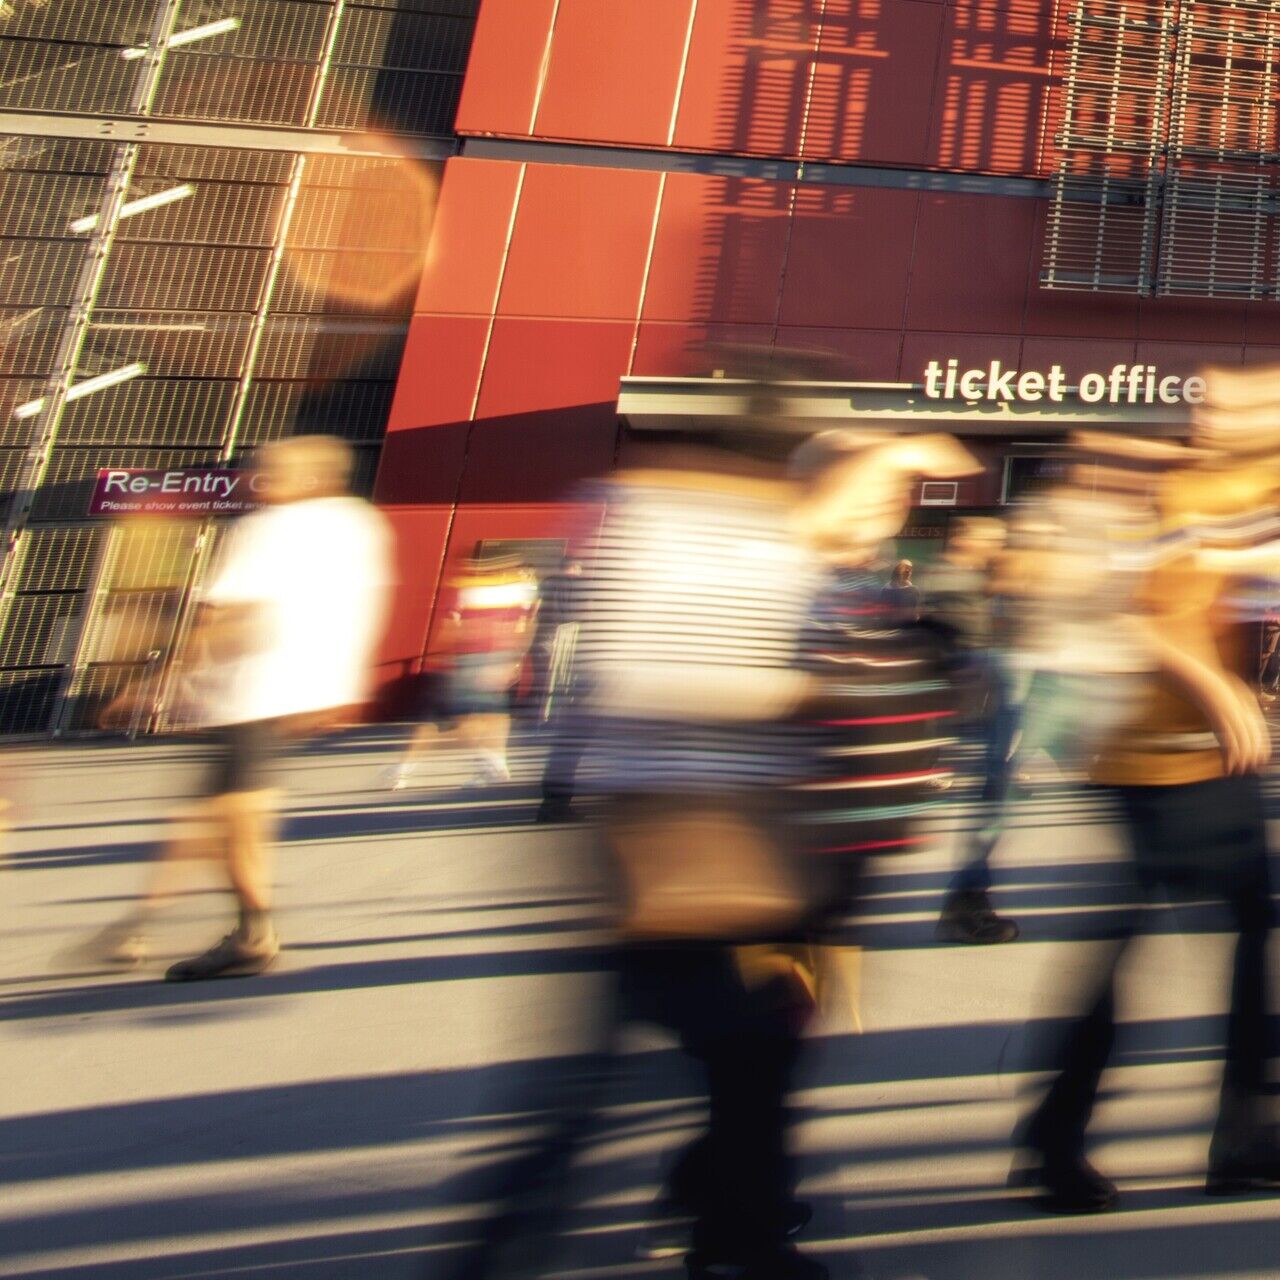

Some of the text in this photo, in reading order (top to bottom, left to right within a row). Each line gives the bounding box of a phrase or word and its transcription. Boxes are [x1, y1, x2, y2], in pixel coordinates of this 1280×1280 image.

[924, 359, 1207, 404] ticket office
[104, 471, 239, 497] Re-Entry
[101, 501, 142, 511] Please
[144, 501, 176, 510] show
[178, 501, 210, 510] event
[212, 500, 242, 510] ticket
